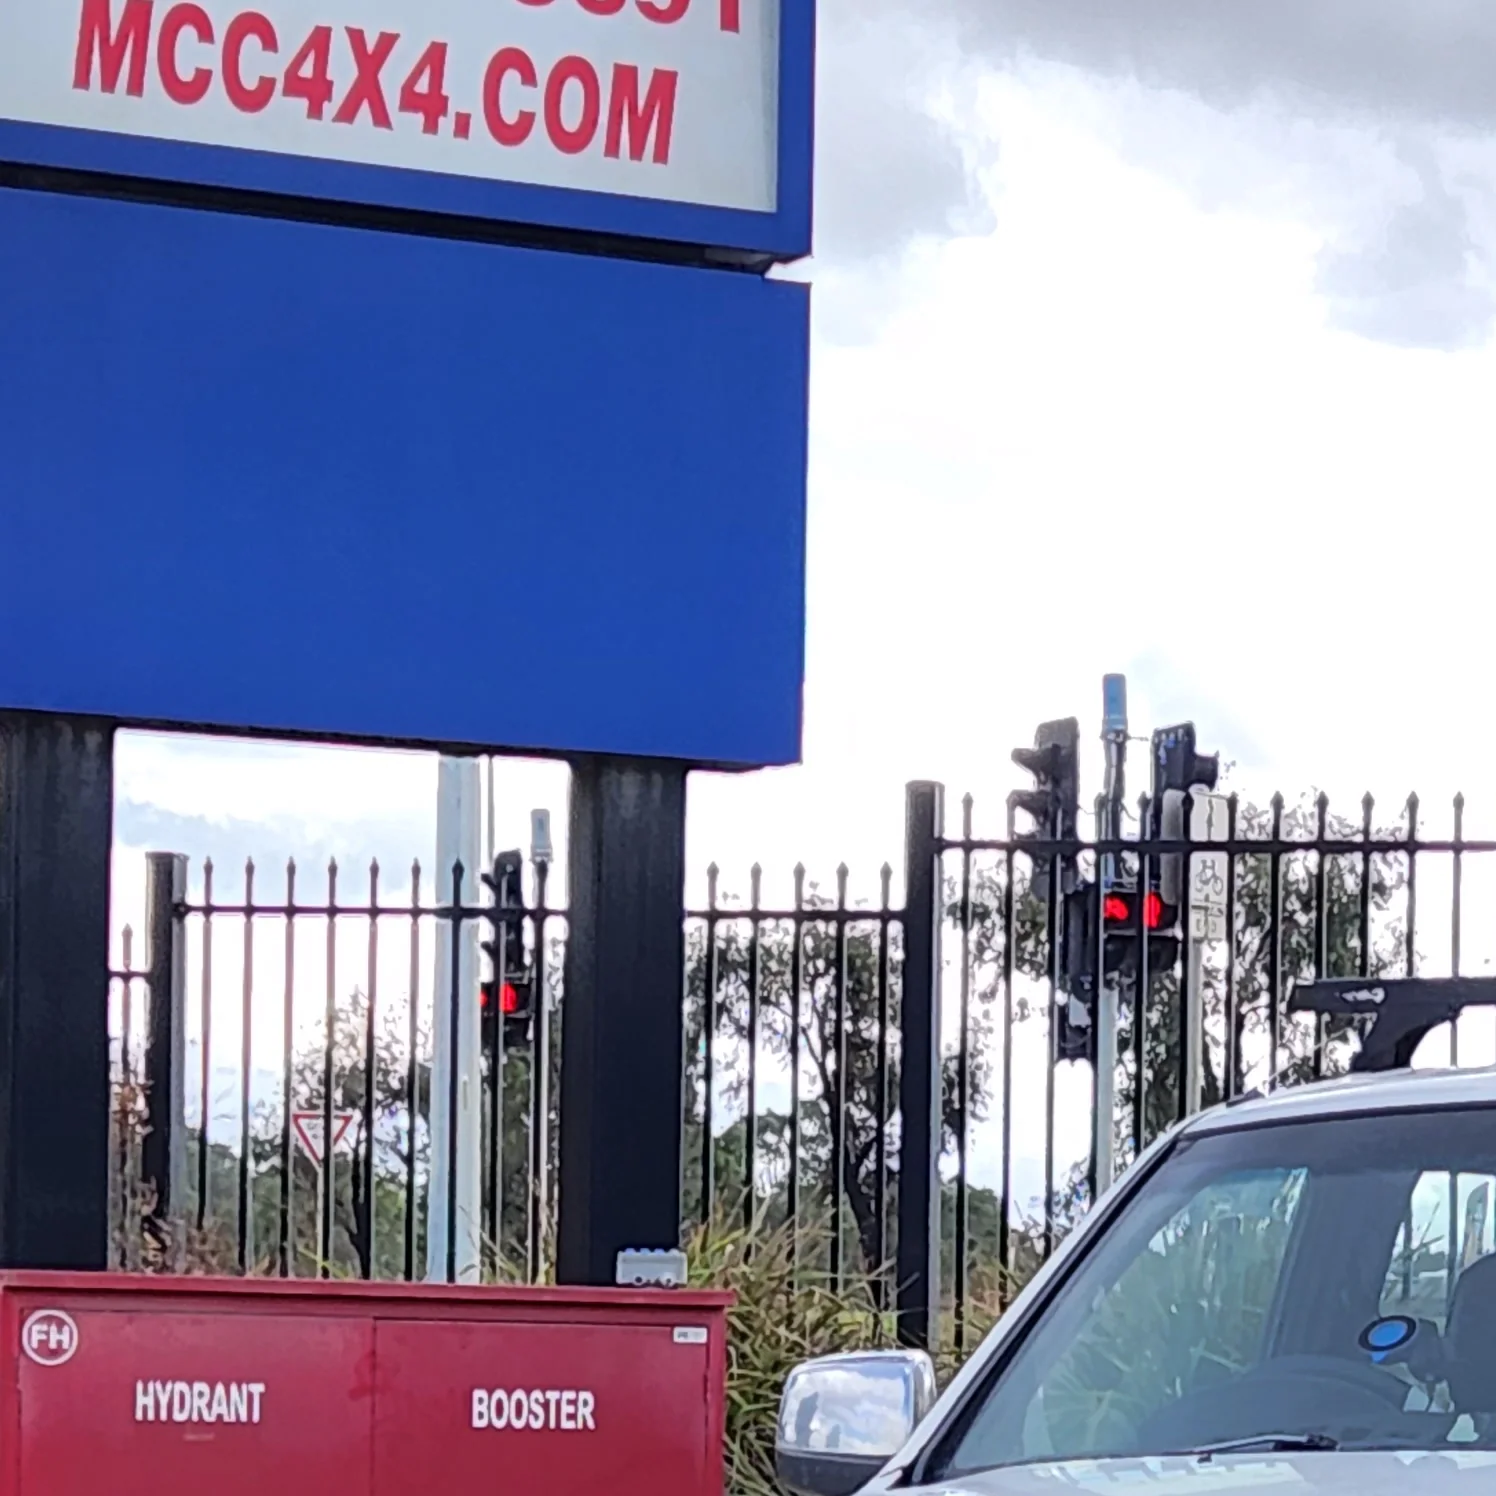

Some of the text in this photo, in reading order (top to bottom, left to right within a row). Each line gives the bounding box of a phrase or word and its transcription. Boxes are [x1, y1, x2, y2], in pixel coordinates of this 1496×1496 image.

[72, 0, 678, 165] MCC4X4.COM
[30, 1323, 71, 1349] FH
[135, 1380, 265, 1423] HYDRANT
[472, 1388, 596, 1430] BOOSTER
